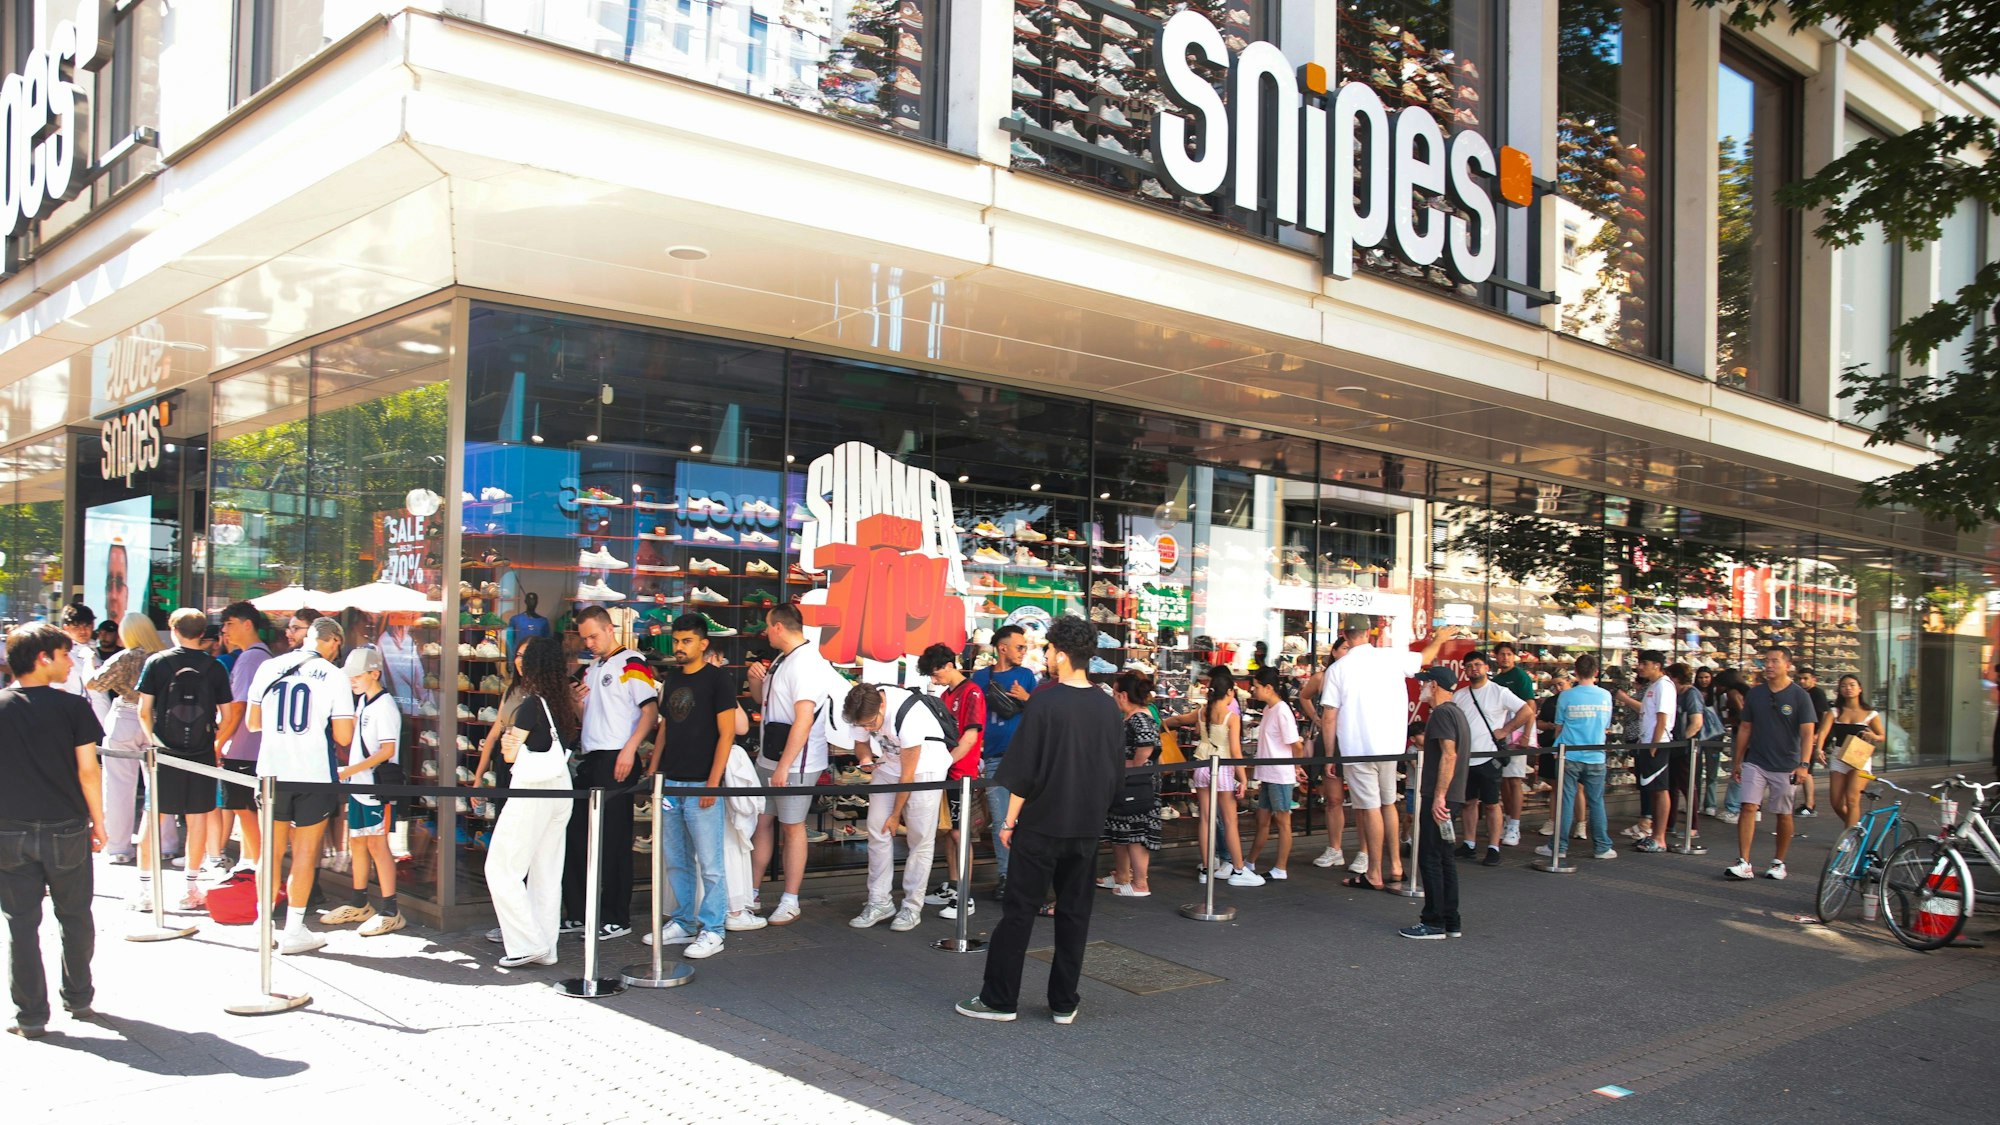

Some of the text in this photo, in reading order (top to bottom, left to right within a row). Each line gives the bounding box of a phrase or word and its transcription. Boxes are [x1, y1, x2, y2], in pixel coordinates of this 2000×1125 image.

[1160, 10, 1497, 283] snipes
[101, 404, 160, 489] snipes
[388, 515, 425, 544] SALE
[800, 440, 969, 596] SUMMER
[271, 681, 312, 735] 10
